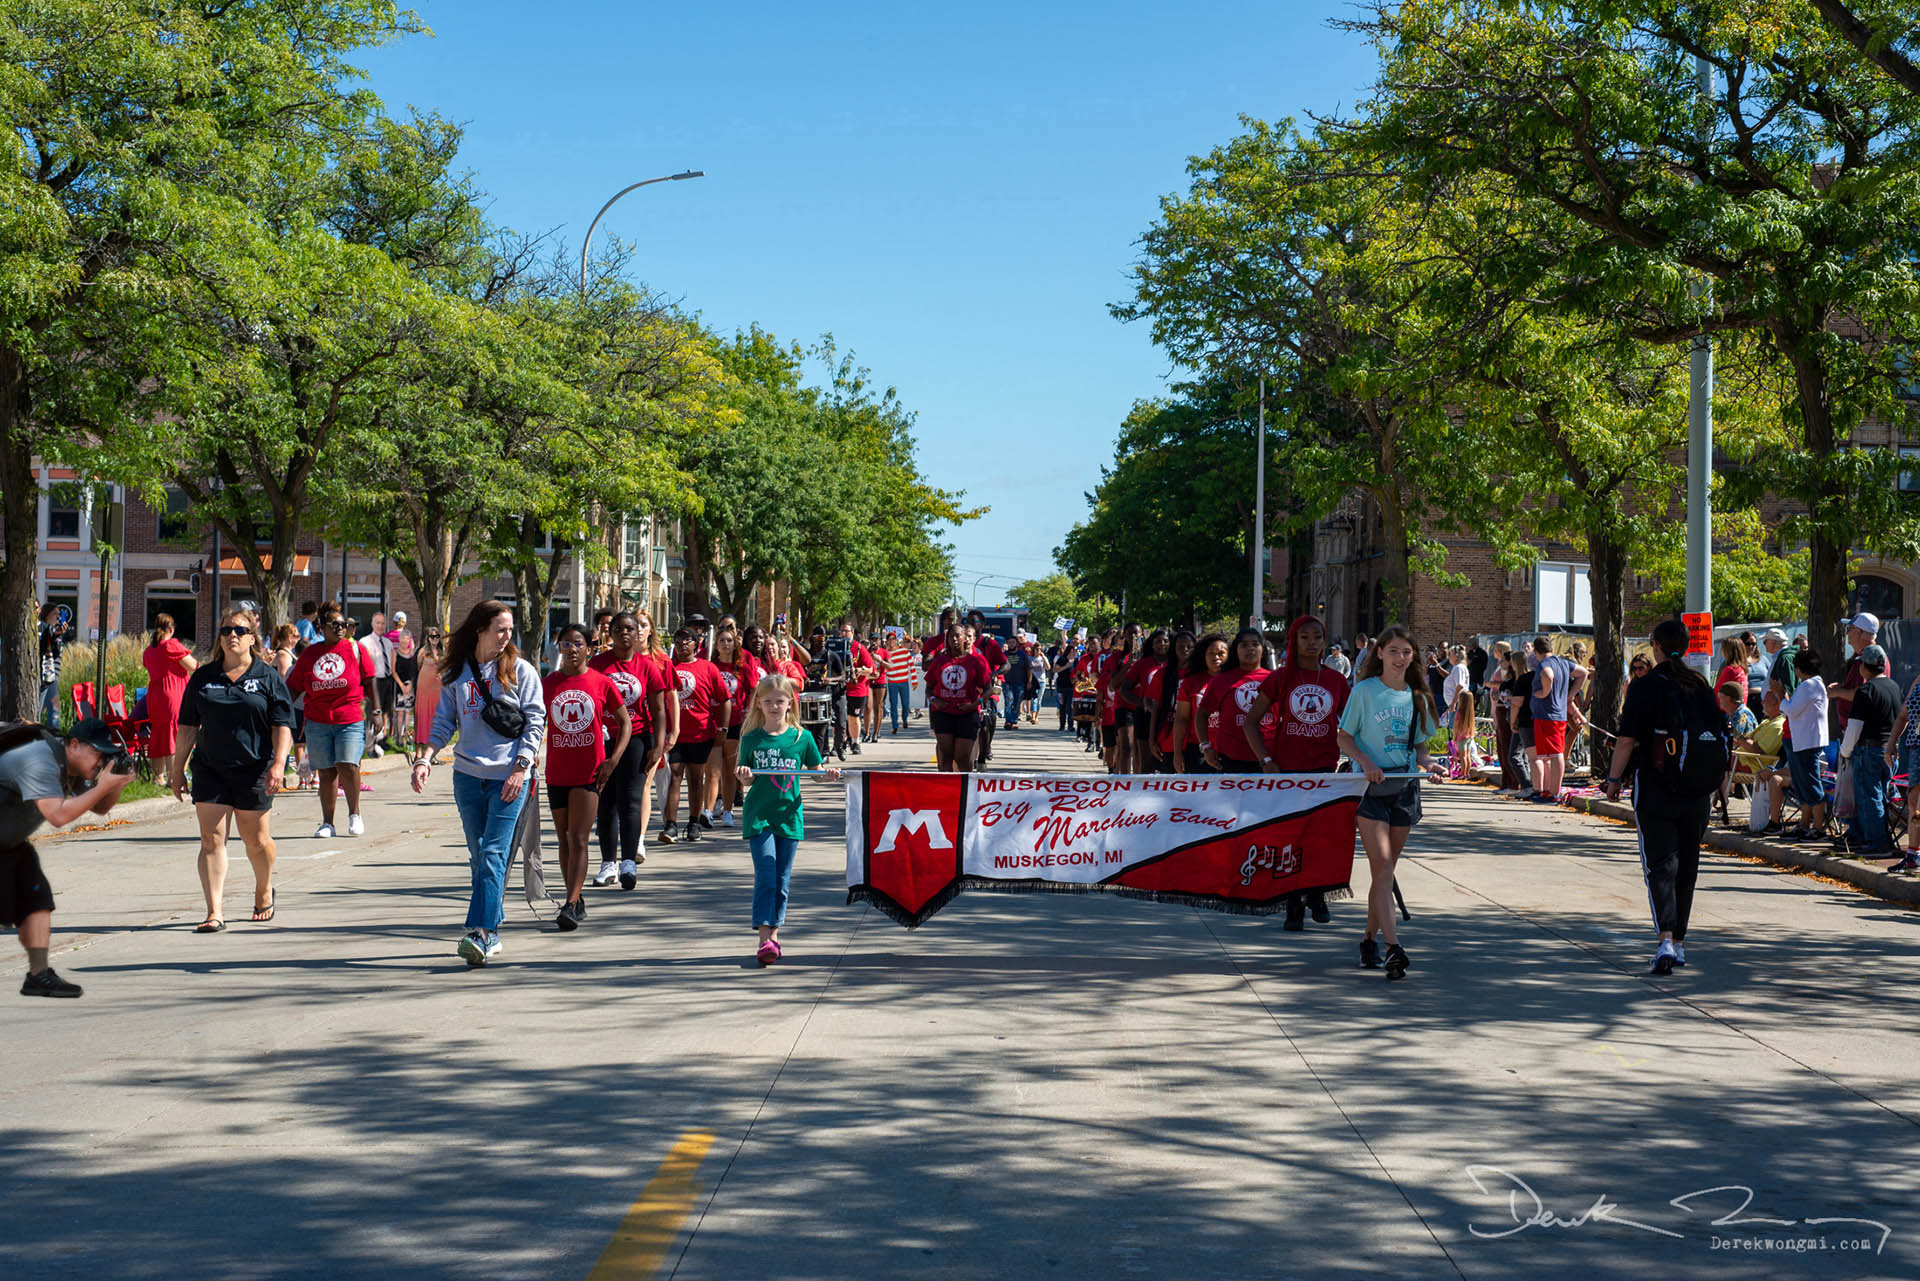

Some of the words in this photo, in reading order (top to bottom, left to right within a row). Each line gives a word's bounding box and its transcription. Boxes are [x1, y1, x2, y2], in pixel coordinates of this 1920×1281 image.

[1687, 624, 1711, 632] ARKING
[1692, 616, 1702, 624] NO
[311, 678, 347, 692] BAND
[553, 692, 589, 708] MUSKEGON
[1287, 722, 1329, 737] BAND
[552, 732, 595, 748] BAND
[770, 757, 797, 769] BACK
[976, 778, 1132, 794] MUSKEGON
[1141, 780, 1209, 793] HIGH
[1218, 778, 1333, 792] SCHOOL
[975, 800, 1033, 828] Big
[1048, 791, 1111, 814] Red
[873, 807, 954, 855] M
[1032, 808, 1160, 853] Marching
[1168, 807, 1238, 831] Band
[993, 851, 1100, 869] MUSKEGON,
[1104, 848, 1123, 865] MI
